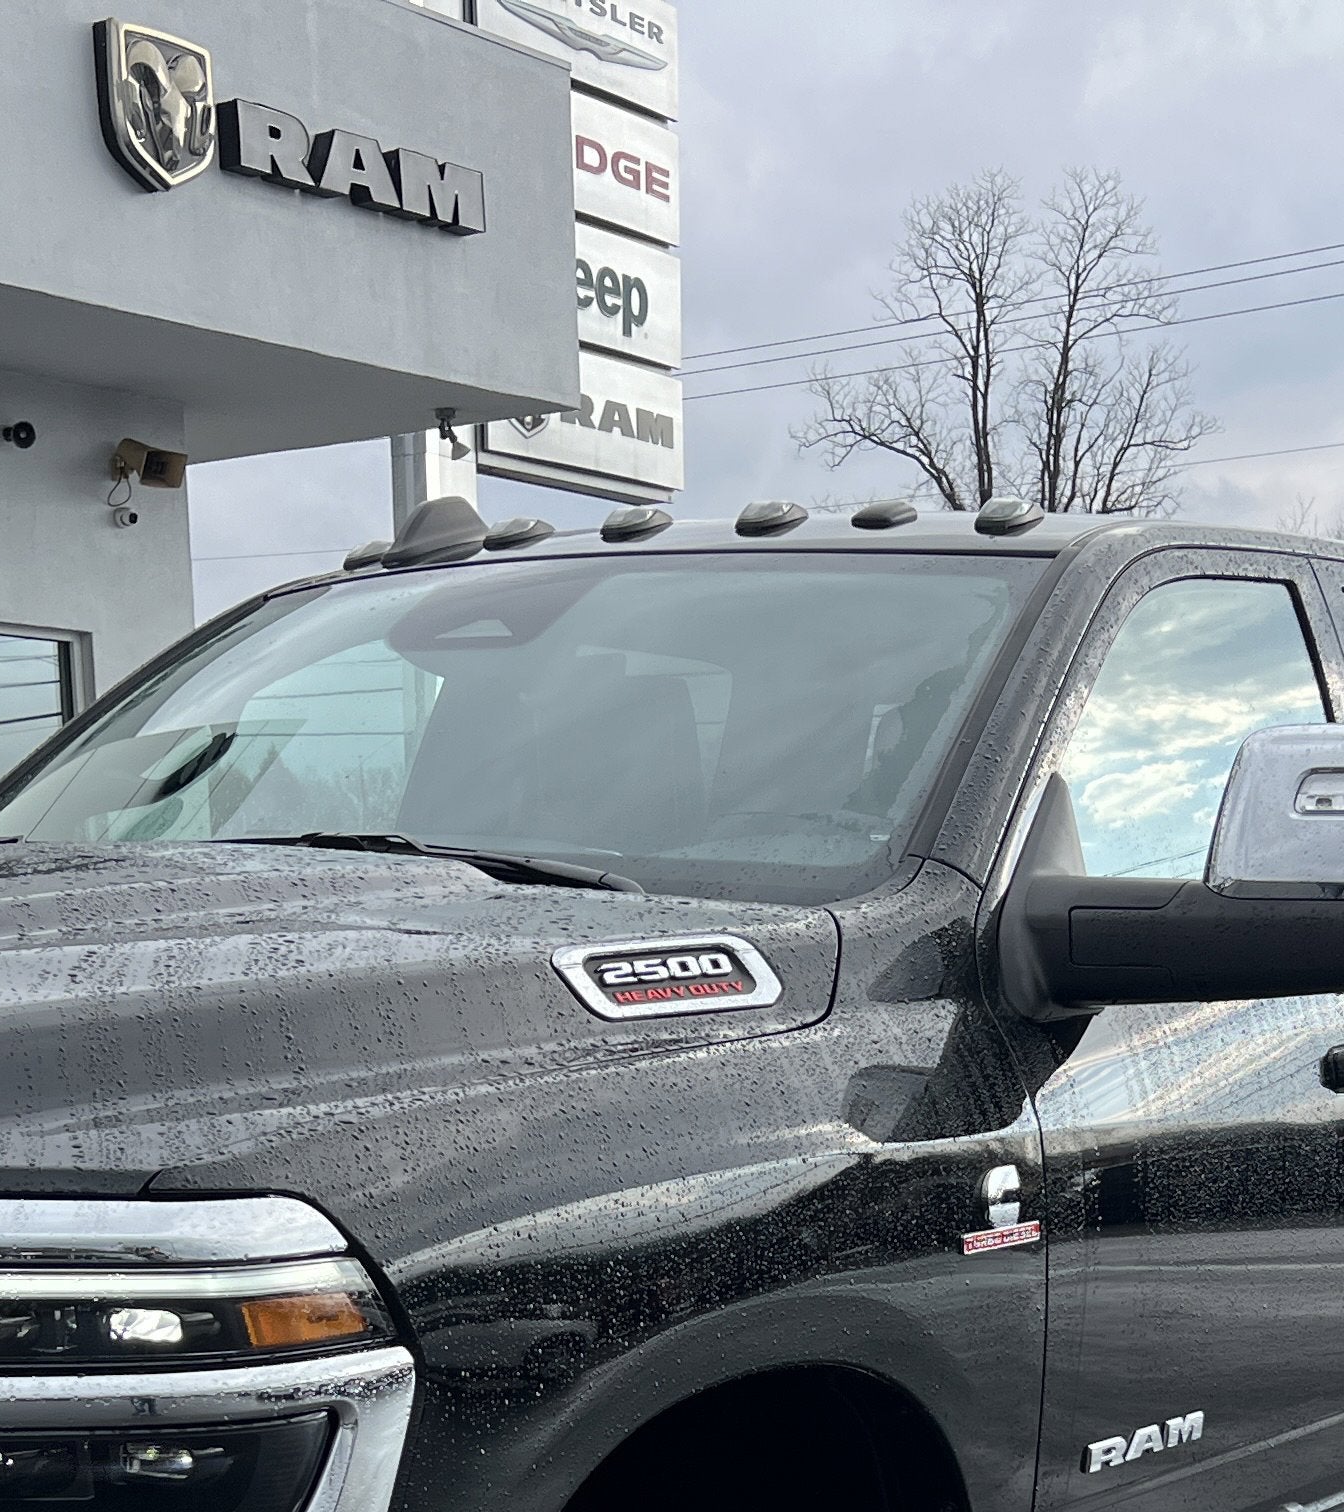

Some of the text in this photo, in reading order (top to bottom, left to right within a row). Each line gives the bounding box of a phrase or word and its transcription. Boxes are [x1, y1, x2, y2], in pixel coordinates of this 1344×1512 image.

[218, 99, 485, 235] RAM
[575, 134, 670, 203] DGE
[575, 258, 649, 338] eep
[594, 952, 733, 987] 2500
[614, 980, 744, 1005] HEAVY DUTY
[1081, 1410, 1205, 1474] RAM
